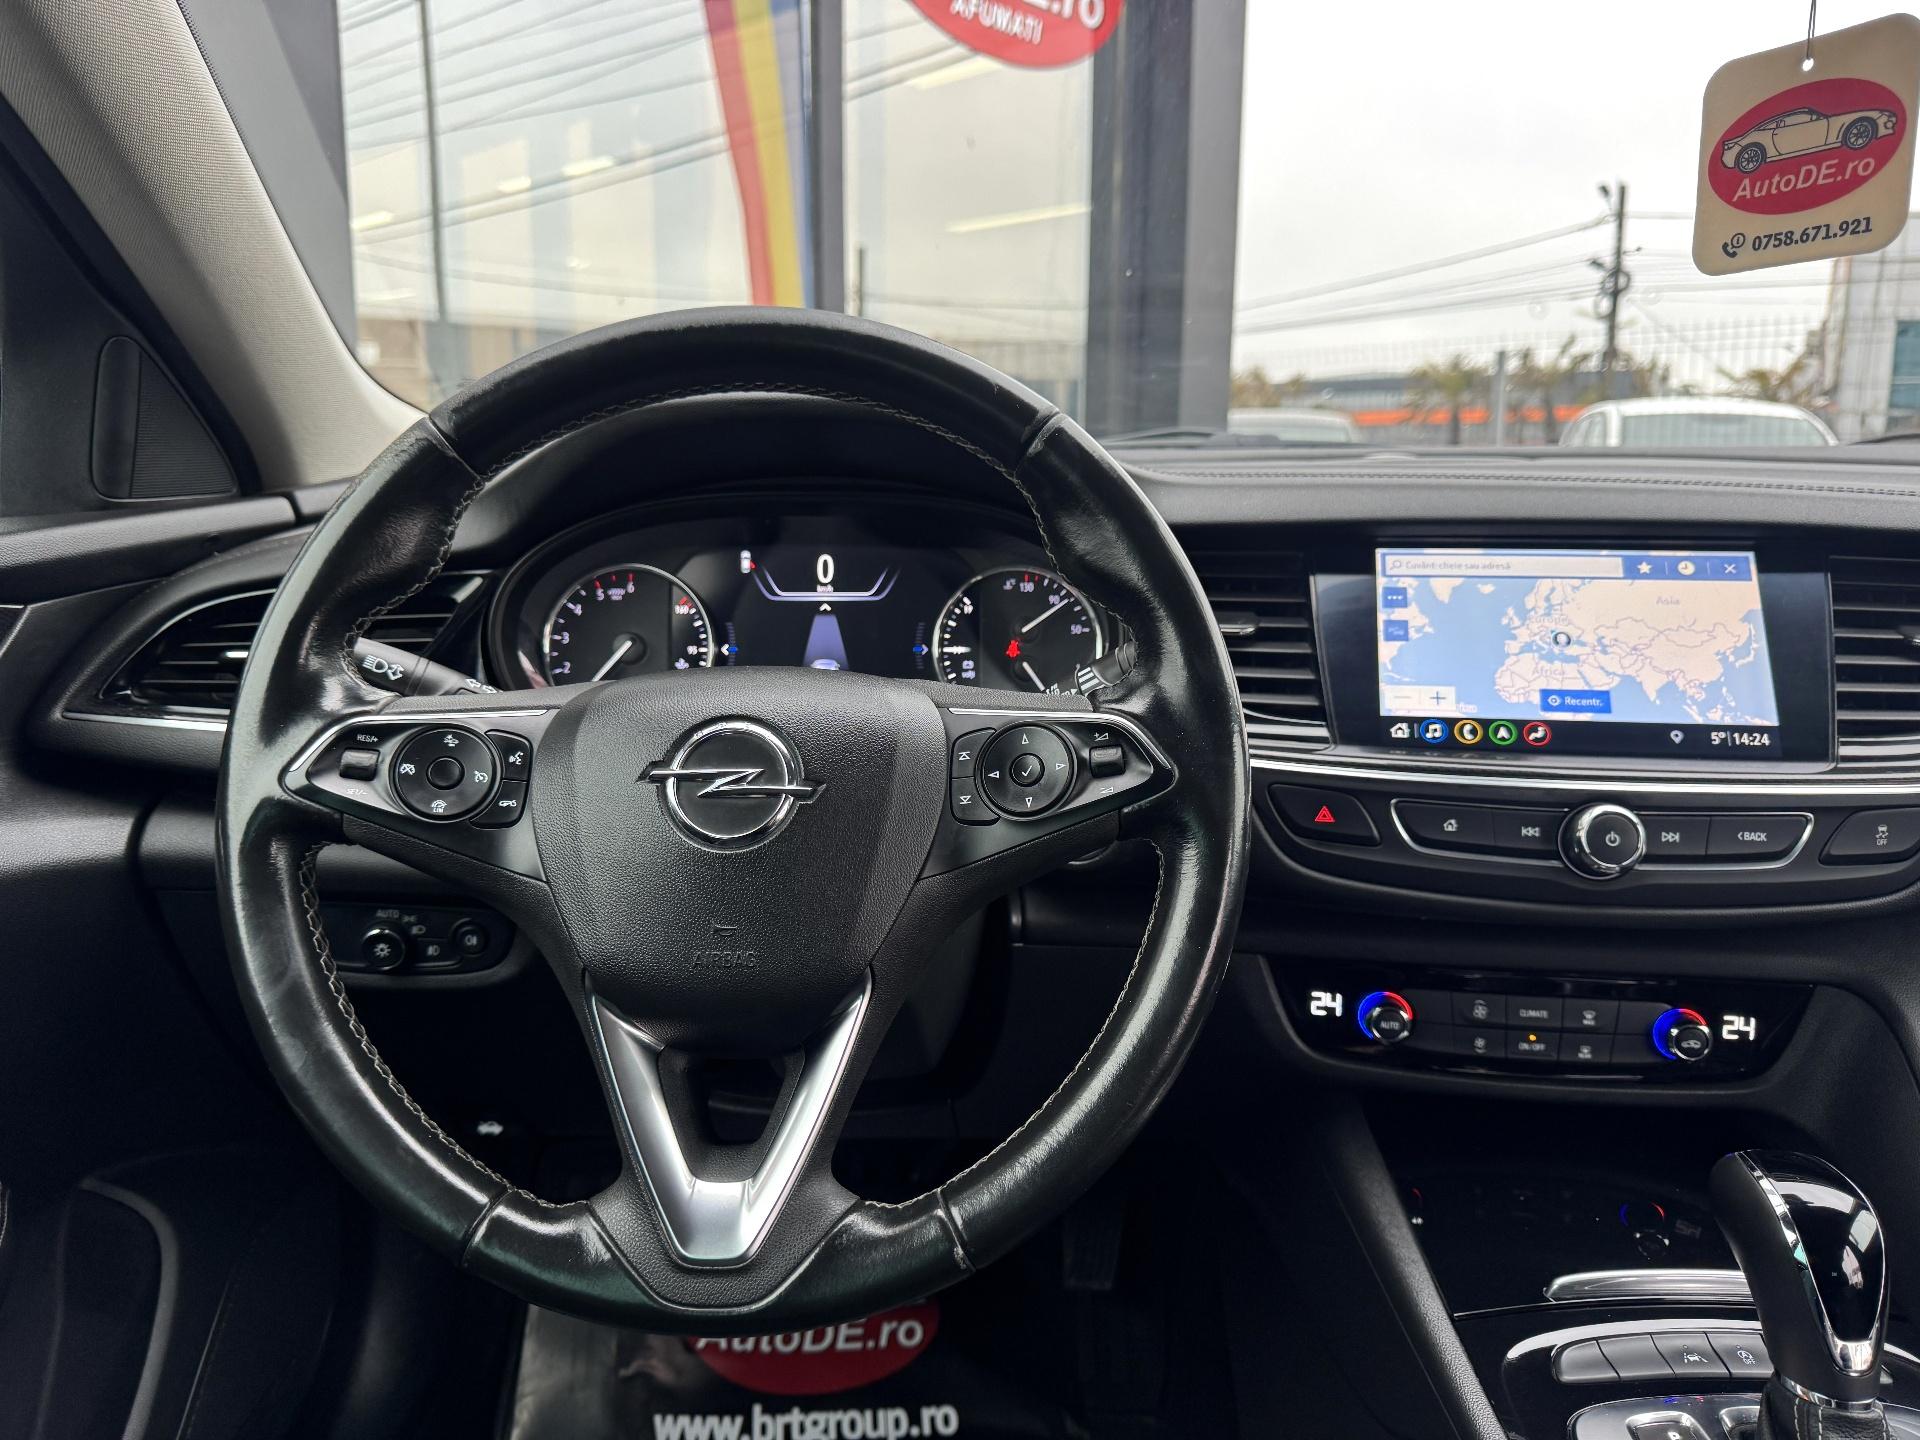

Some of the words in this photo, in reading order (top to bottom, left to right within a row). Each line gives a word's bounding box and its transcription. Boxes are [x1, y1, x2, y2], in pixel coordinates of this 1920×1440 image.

[1733, 157, 1875, 202] AutoDE.ro
[1752, 217, 1872, 251] 0758.671.921
[816, 553, 834, 584] 0
[1655, 596, 1680, 605] Asia
[1070, 623, 1082, 635] 50
[560, 631, 570, 644] 3
[562, 661, 571, 674] 2
[1564, 695, 1604, 707] Recentr.
[1733, 732, 1771, 746] 14:24
[376, 909, 400, 918] AUTO
[694, 951, 757, 968] AIRBAG
[1310, 991, 1342, 1017] 24
[1519, 1008, 1548, 1019] CLIMATE
[1379, 1020, 1400, 1031] AUTO
[1721, 1015, 1756, 1041] 24
[653, 1403, 959, 1440] www.brtgroup.ro
